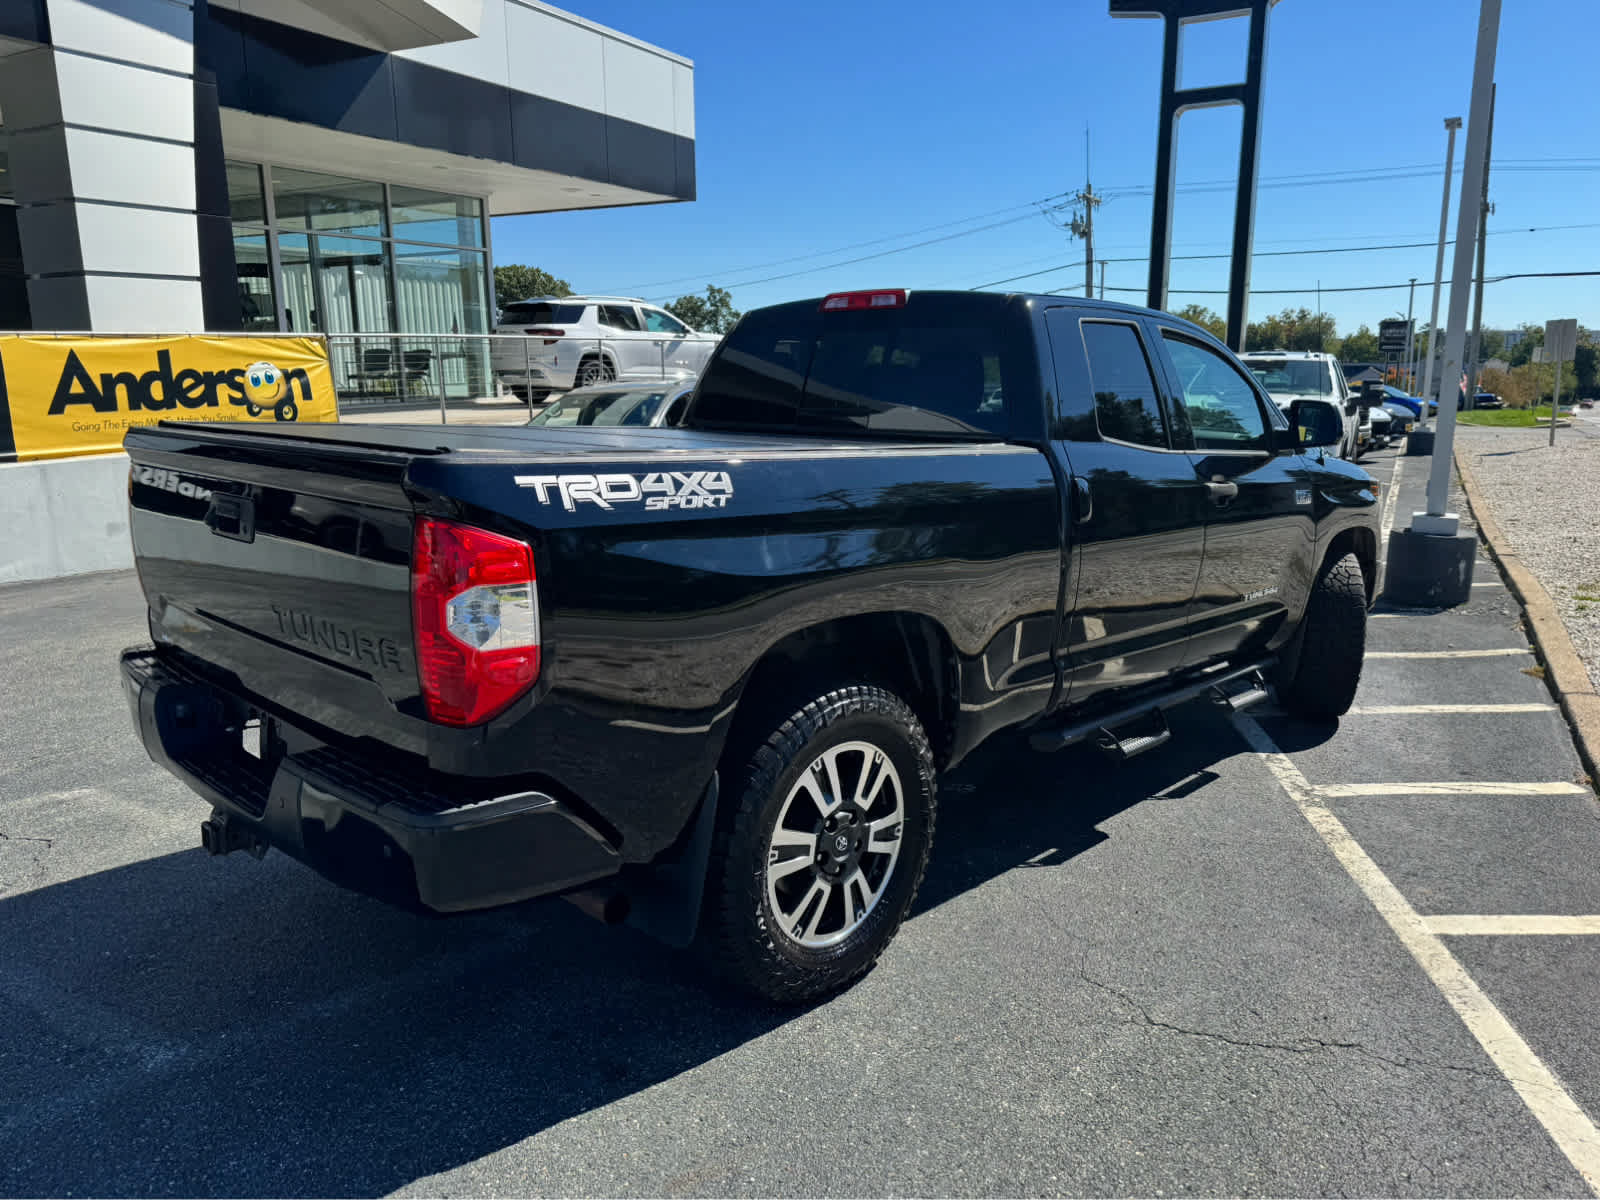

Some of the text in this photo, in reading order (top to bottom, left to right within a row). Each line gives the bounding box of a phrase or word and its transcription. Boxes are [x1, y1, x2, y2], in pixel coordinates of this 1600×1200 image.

[71, 421, 101, 432] Going
[103, 418, 120, 430] The
[514, 473, 642, 513] TRD
[644, 493, 733, 511] SPORT
[271, 604, 404, 673] TUNDRA
